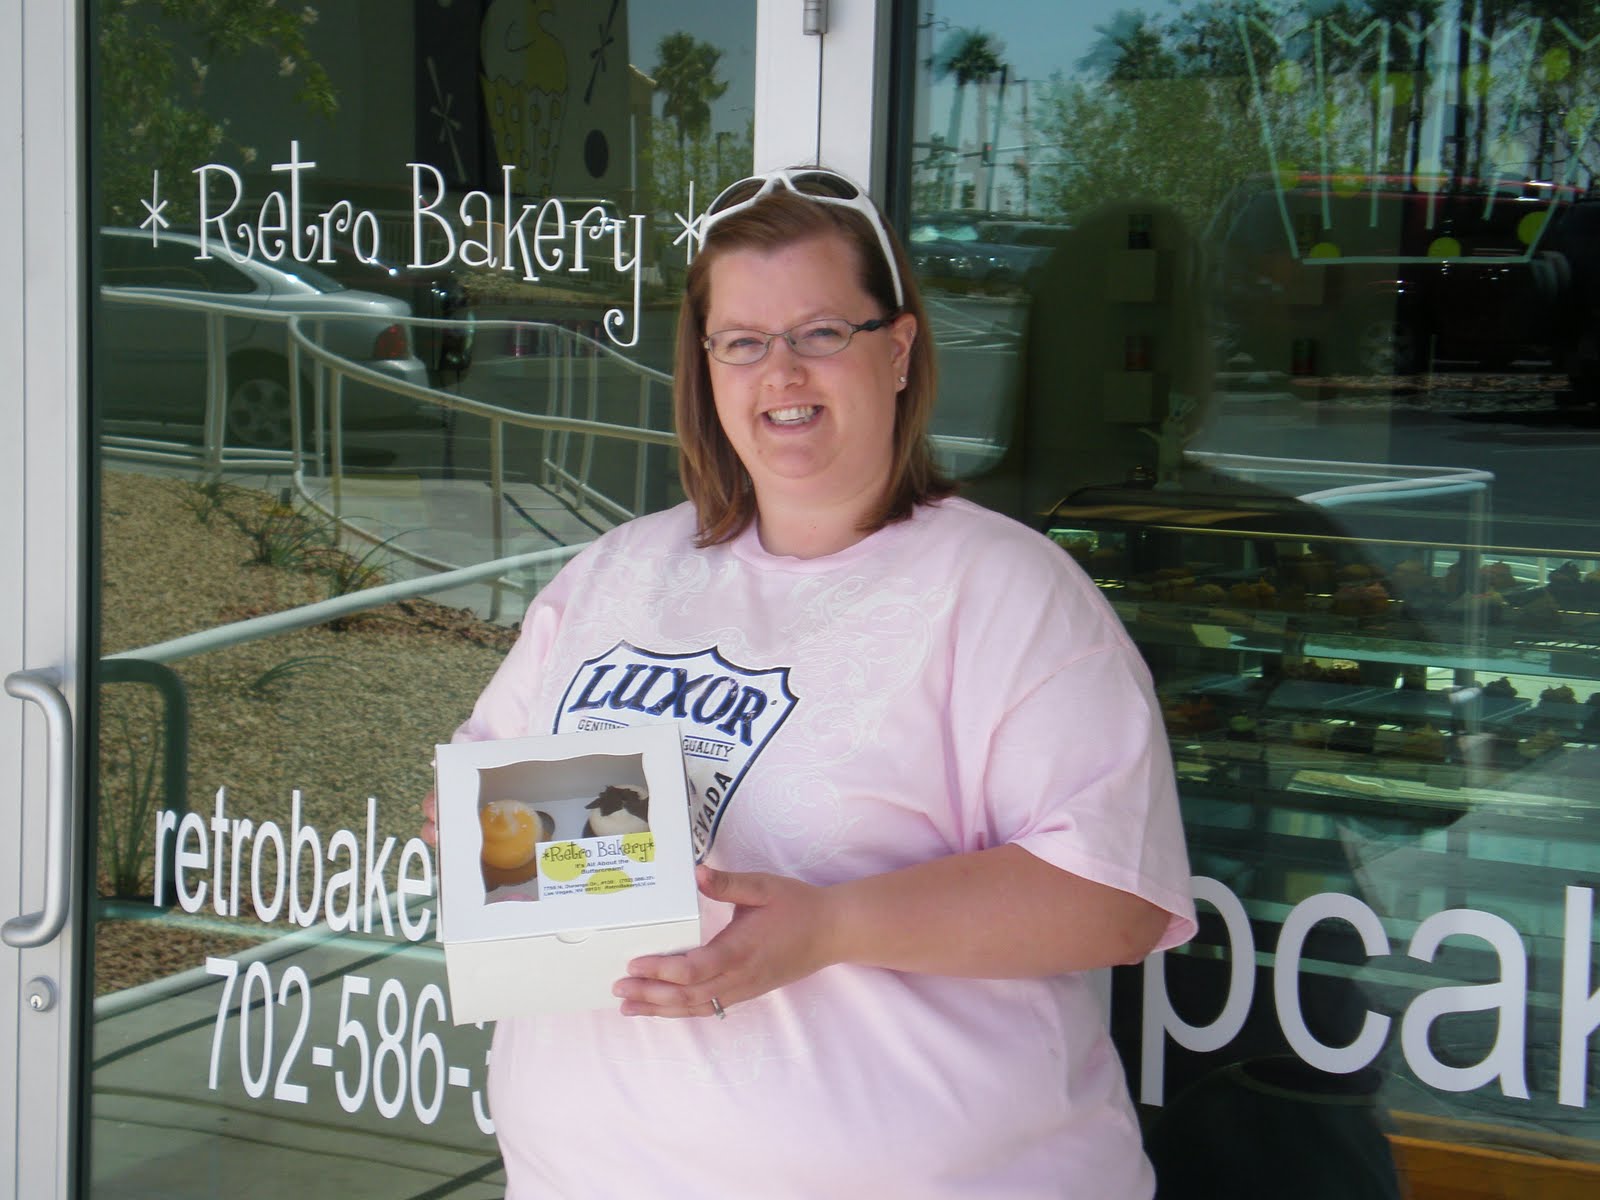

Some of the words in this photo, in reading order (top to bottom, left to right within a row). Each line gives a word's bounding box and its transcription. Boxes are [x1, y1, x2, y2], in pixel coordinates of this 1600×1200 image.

[192, 140, 380, 264] Retro
[406, 162, 646, 347] Bakery
[567, 663, 768, 746] LUXOR
[577, 719, 626, 731] GENUI
[683, 738, 735, 757] QUALITY
[153, 785, 443, 943] retrobake
